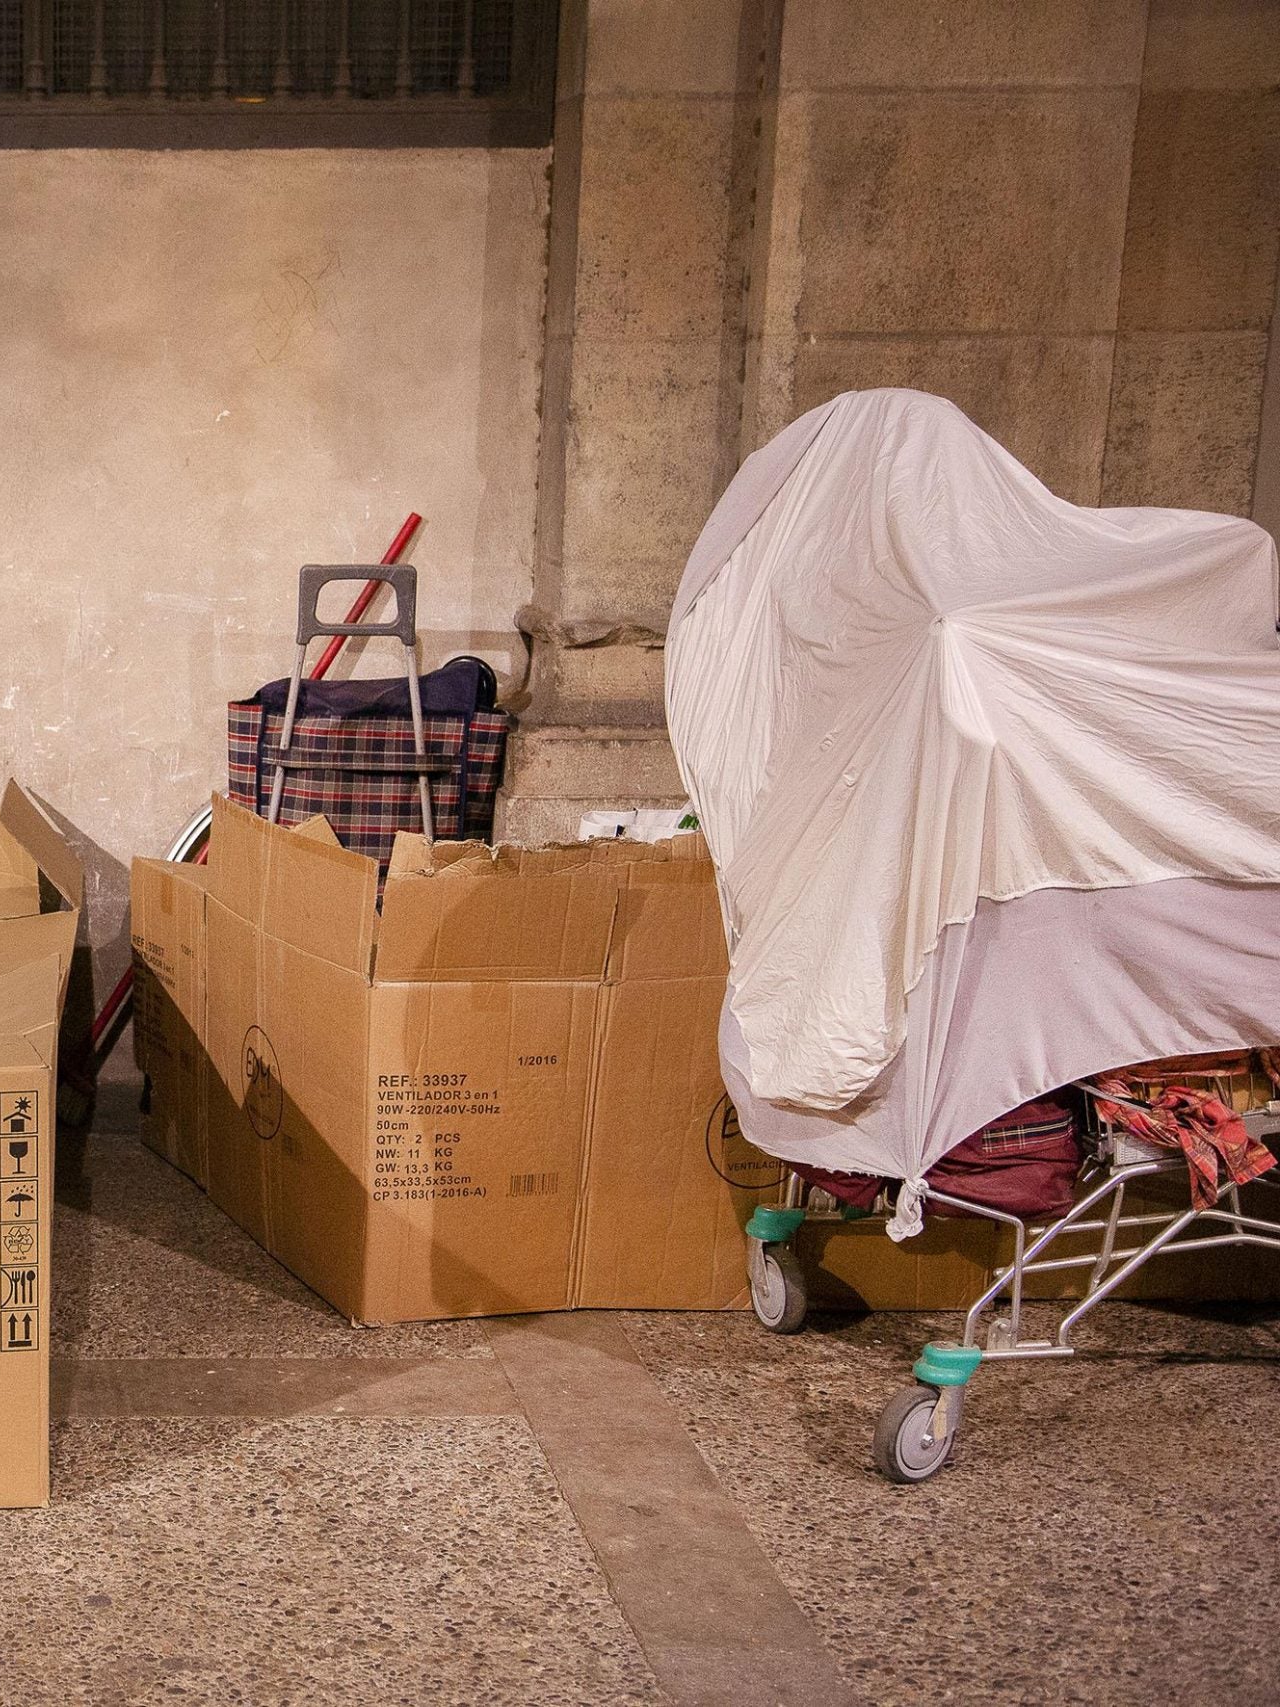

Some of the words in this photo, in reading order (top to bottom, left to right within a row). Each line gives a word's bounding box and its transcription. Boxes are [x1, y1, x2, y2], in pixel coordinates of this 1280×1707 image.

[518, 1055, 557, 1066] 1/2016
[422, 1074, 468, 1087] 33937
[378, 1090, 461, 1101] VENTILADOR
[464, 1090, 471, 1100] 3
[474, 1091, 489, 1100] en
[492, 1090, 498, 1100] 1
[376, 1120, 409, 1131] 50cm
[376, 1135, 405, 1146] QTY:
[415, 1134, 422, 1144] 2
[435, 1133, 461, 1144] PCS
[375, 1149, 400, 1159] NW:
[407, 1149, 420, 1159] 11
[434, 1147, 453, 1157] KG
[375, 1163, 400, 1173] GW:
[434, 1162, 453, 1172] KG
[373, 1191, 390, 1201] CP
